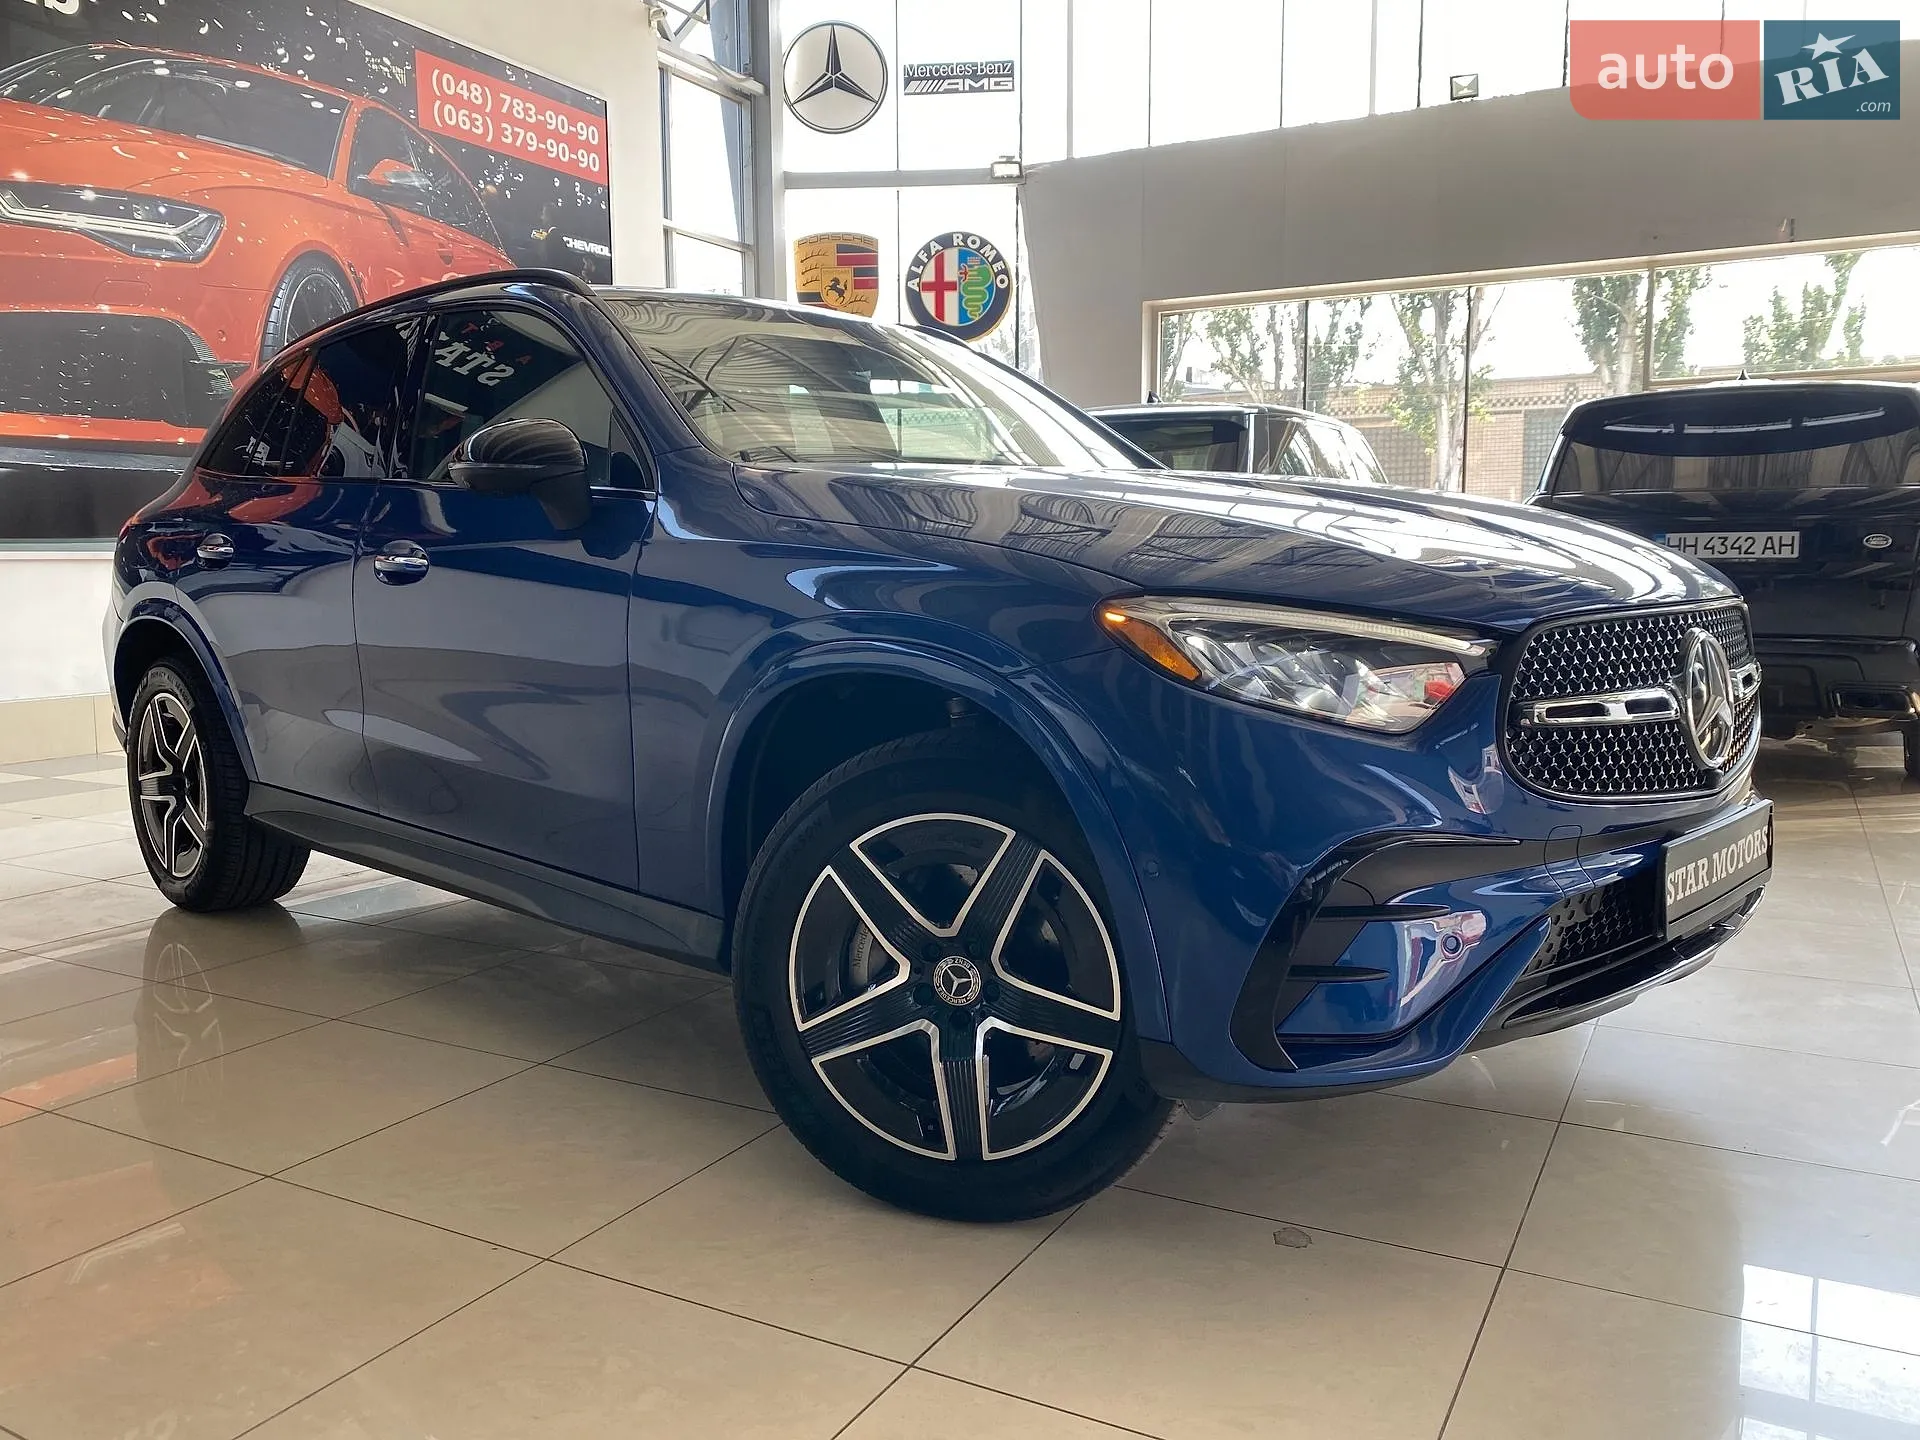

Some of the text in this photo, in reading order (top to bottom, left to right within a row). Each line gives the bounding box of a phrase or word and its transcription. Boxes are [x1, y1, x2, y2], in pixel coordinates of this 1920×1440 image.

[904, 61, 1012, 78] Mercedes-Benz
[937, 77, 1013, 92] AMG
[432, 69, 491, 112] (048)
[500, 93, 599, 145] 783-90-90
[433, 100, 600, 172] (063) 379-90-90
[797, 232, 876, 248] PORSCHE
[907, 233, 1009, 293] ALFA ROMEO
[1704, 536, 1756, 555] 4342
[1761, 536, 1795, 555] AH
[1667, 825, 1768, 906] STAR MOTORS
